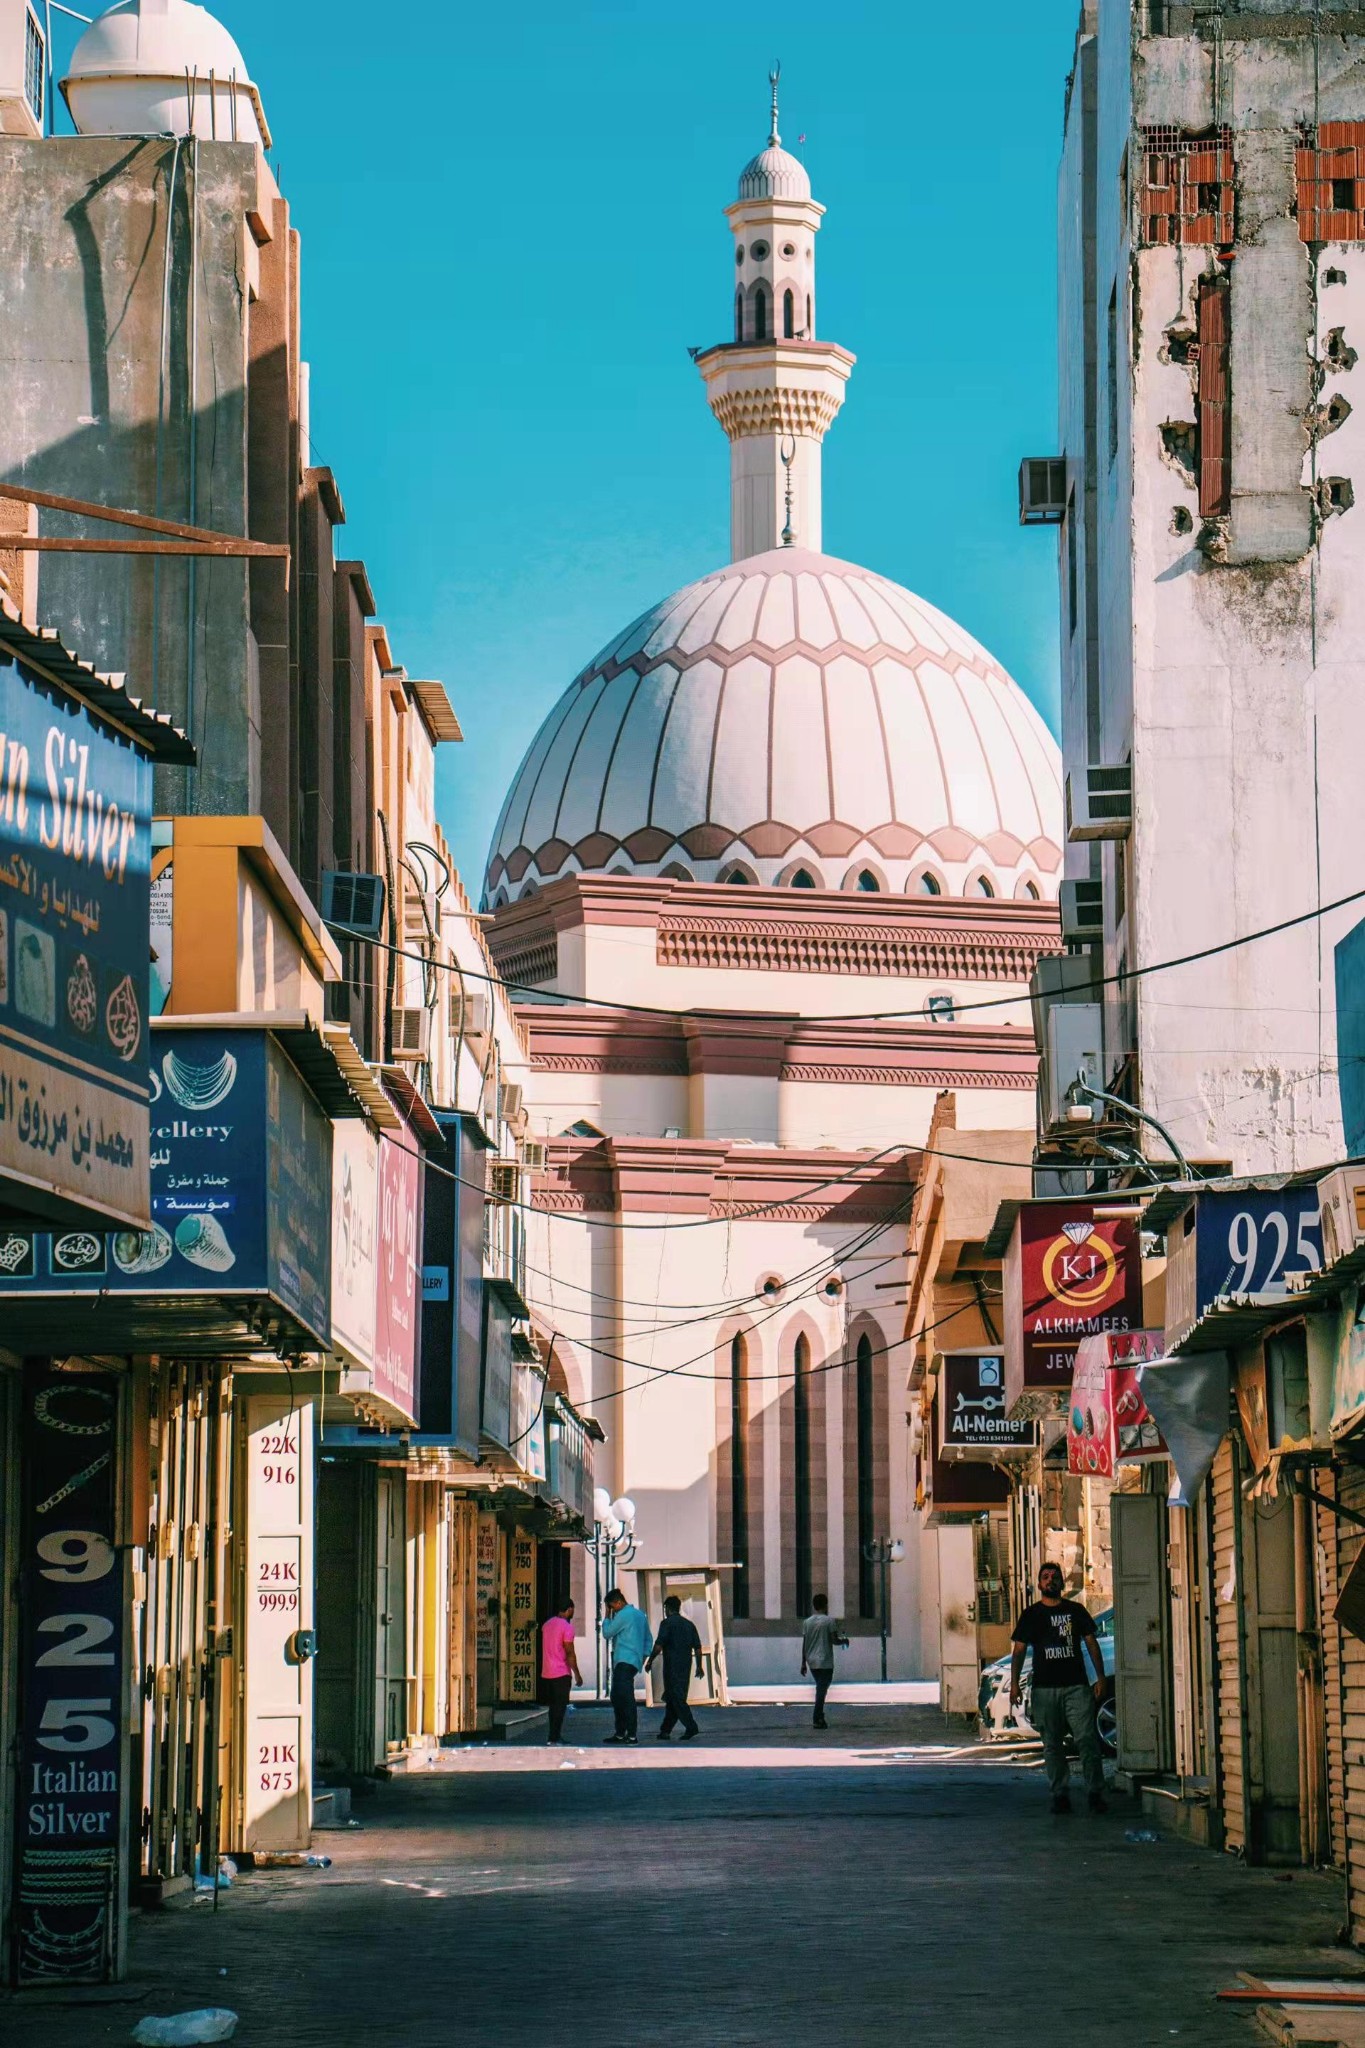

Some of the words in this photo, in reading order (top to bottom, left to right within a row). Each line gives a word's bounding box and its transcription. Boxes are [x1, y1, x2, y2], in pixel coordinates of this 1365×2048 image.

[0, 732, 28, 830] n
[40, 726, 136, 885] Silver
[18, 1078, 67, 1156] مرزوق
[72, 1104, 91, 1173] بن
[95, 1118, 133, 1168] محمد
[167, 1174, 193, 1188] مفرق
[204, 1173, 230, 1188] جملة
[1228, 1211, 1320, 1294] 925
[1060, 1255, 1098, 1280] KJ
[423, 1278, 443, 1288] LLERY
[1034, 1317, 1129, 1334] ALKHAMEES
[1046, 1353, 1077, 1369] JEW
[952, 1415, 1026, 1433] Al-Nemer
[261, 1436, 297, 1454] 22K
[263, 1466, 295, 1484] 916
[515, 1542, 532, 1555] 18K
[515, 1556, 532, 1568] 750
[259, 1563, 297, 1581] 24K
[514, 1582, 532, 1595] 21K
[259, 1594, 297, 1612] 999.9
[515, 1597, 531, 1609] 875
[1051, 1614, 1072, 1626] MAKE
[514, 1629, 532, 1641] 22K
[1059, 1625, 1072, 1636] ART
[515, 1643, 532, 1655] 916
[1045, 1647, 1062, 1660] YOUR
[1062, 1646, 1074, 1657] LIFE
[514, 1666, 531, 1678] 24K
[259, 1745, 296, 1764] 21K
[31, 1762, 117, 1794] Italian
[260, 1772, 292, 1791] 875
[28, 1803, 111, 1835] Silver
